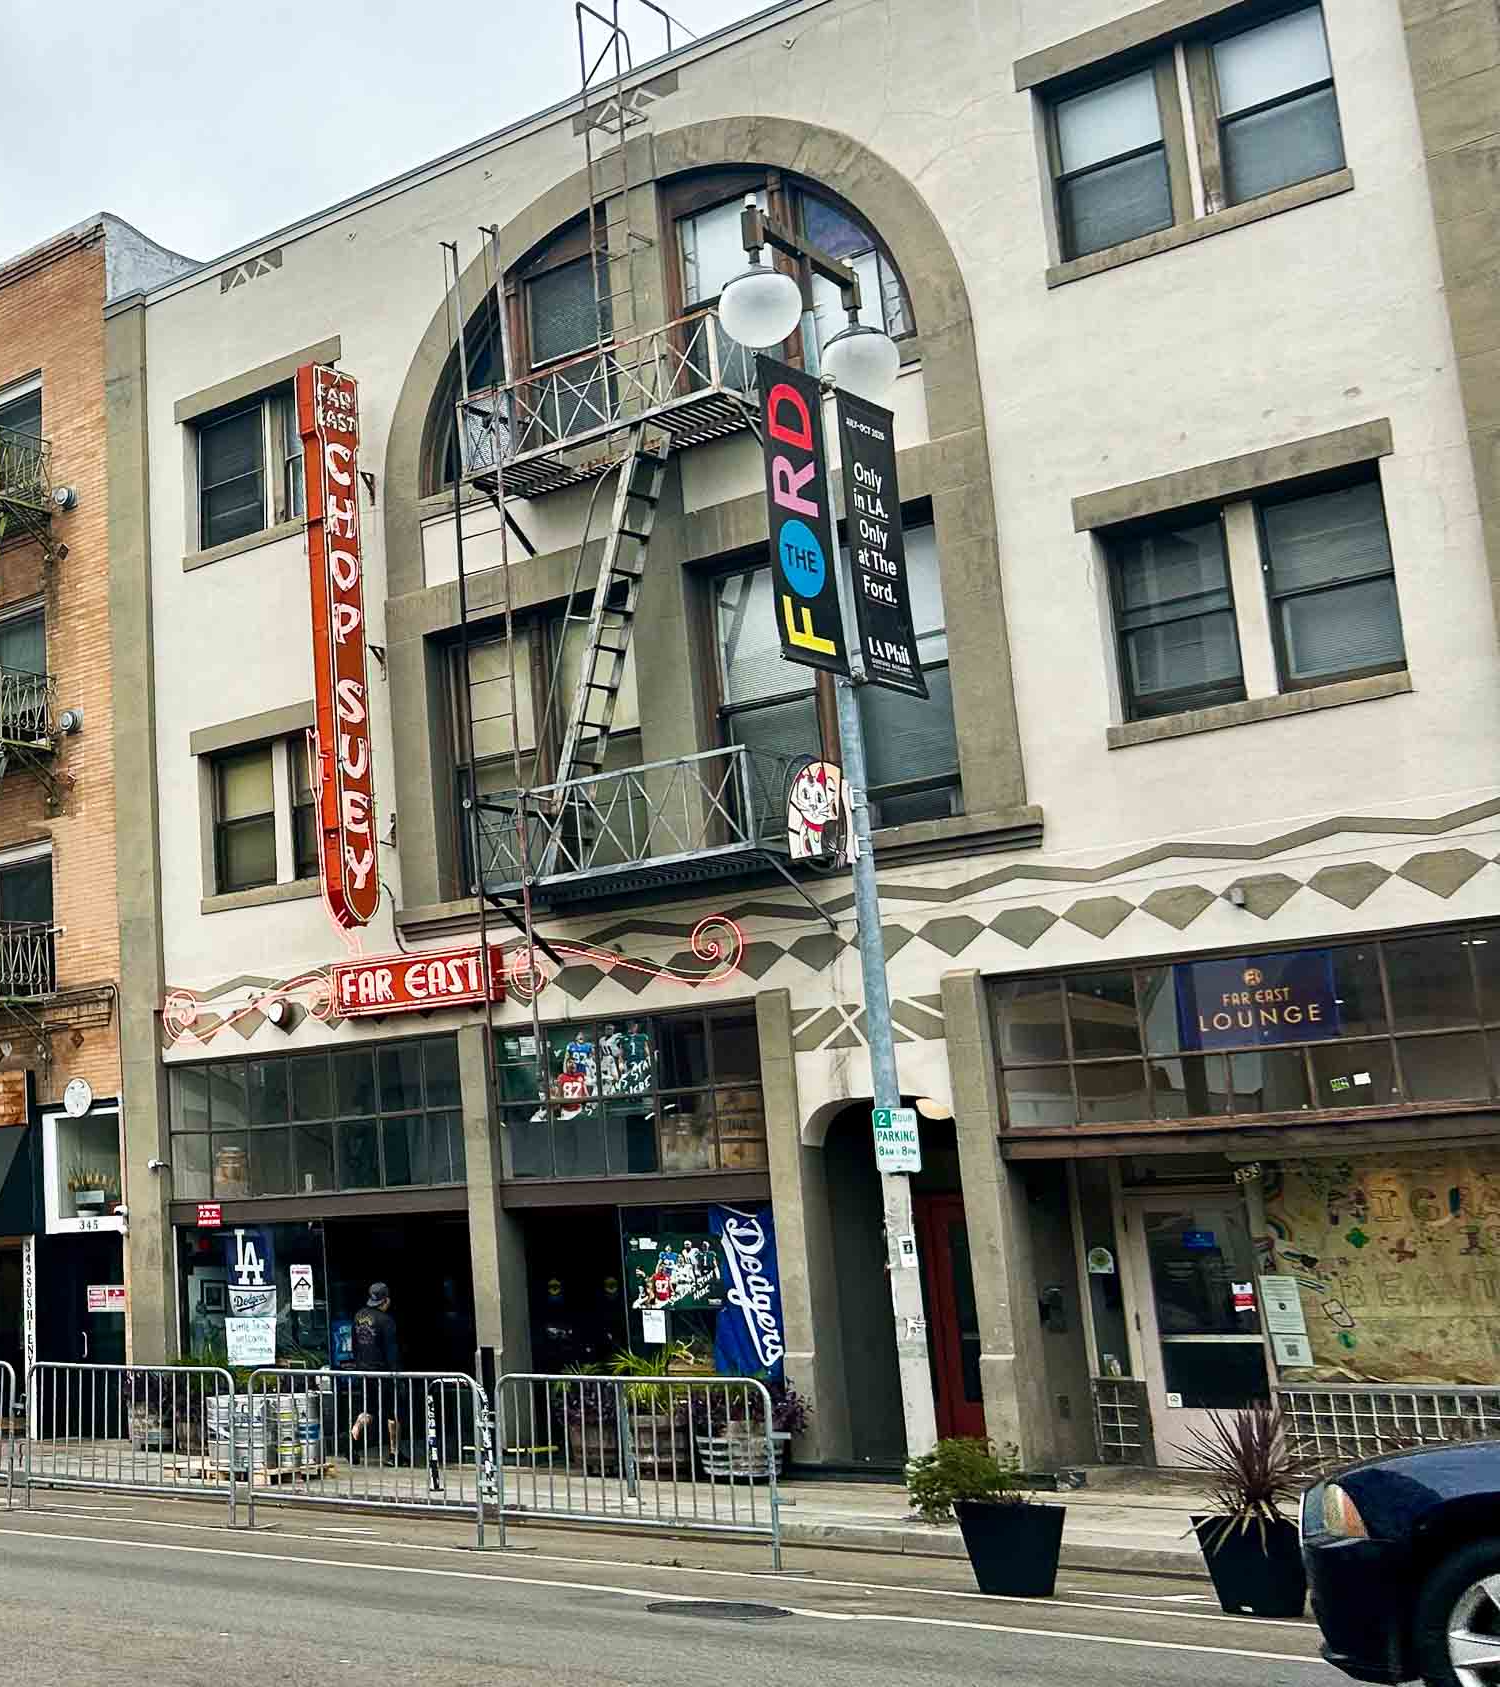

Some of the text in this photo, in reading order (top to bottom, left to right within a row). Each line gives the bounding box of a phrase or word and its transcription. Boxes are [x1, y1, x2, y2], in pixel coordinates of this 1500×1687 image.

[853, 461, 882, 494] Only
[853, 487, 889, 519] in LA.
[325, 442, 362, 644] CHOP
[860, 519, 888, 550] Only
[784, 543, 819, 574] THE
[858, 549, 897, 576] at The
[863, 574, 898, 603] Ford.
[868, 636, 910, 665] LA Phil
[337, 679, 374, 889] SUEY
[340, 957, 480, 1006] FAR EAST
[1222, 987, 1291, 1007] FAR EAST
[1198, 1003, 1323, 1032] LOUNGE
[563, 1081, 583, 1098] 87
[877, 1111, 887, 1126] 2
[877, 1130, 916, 1142] PARKING
[79, 1220, 99, 1230] 345
[234, 1229, 265, 1285] LA
[233, 1293, 268, 1312] Dodgers
[721, 1217, 786, 1367] Dodgers
